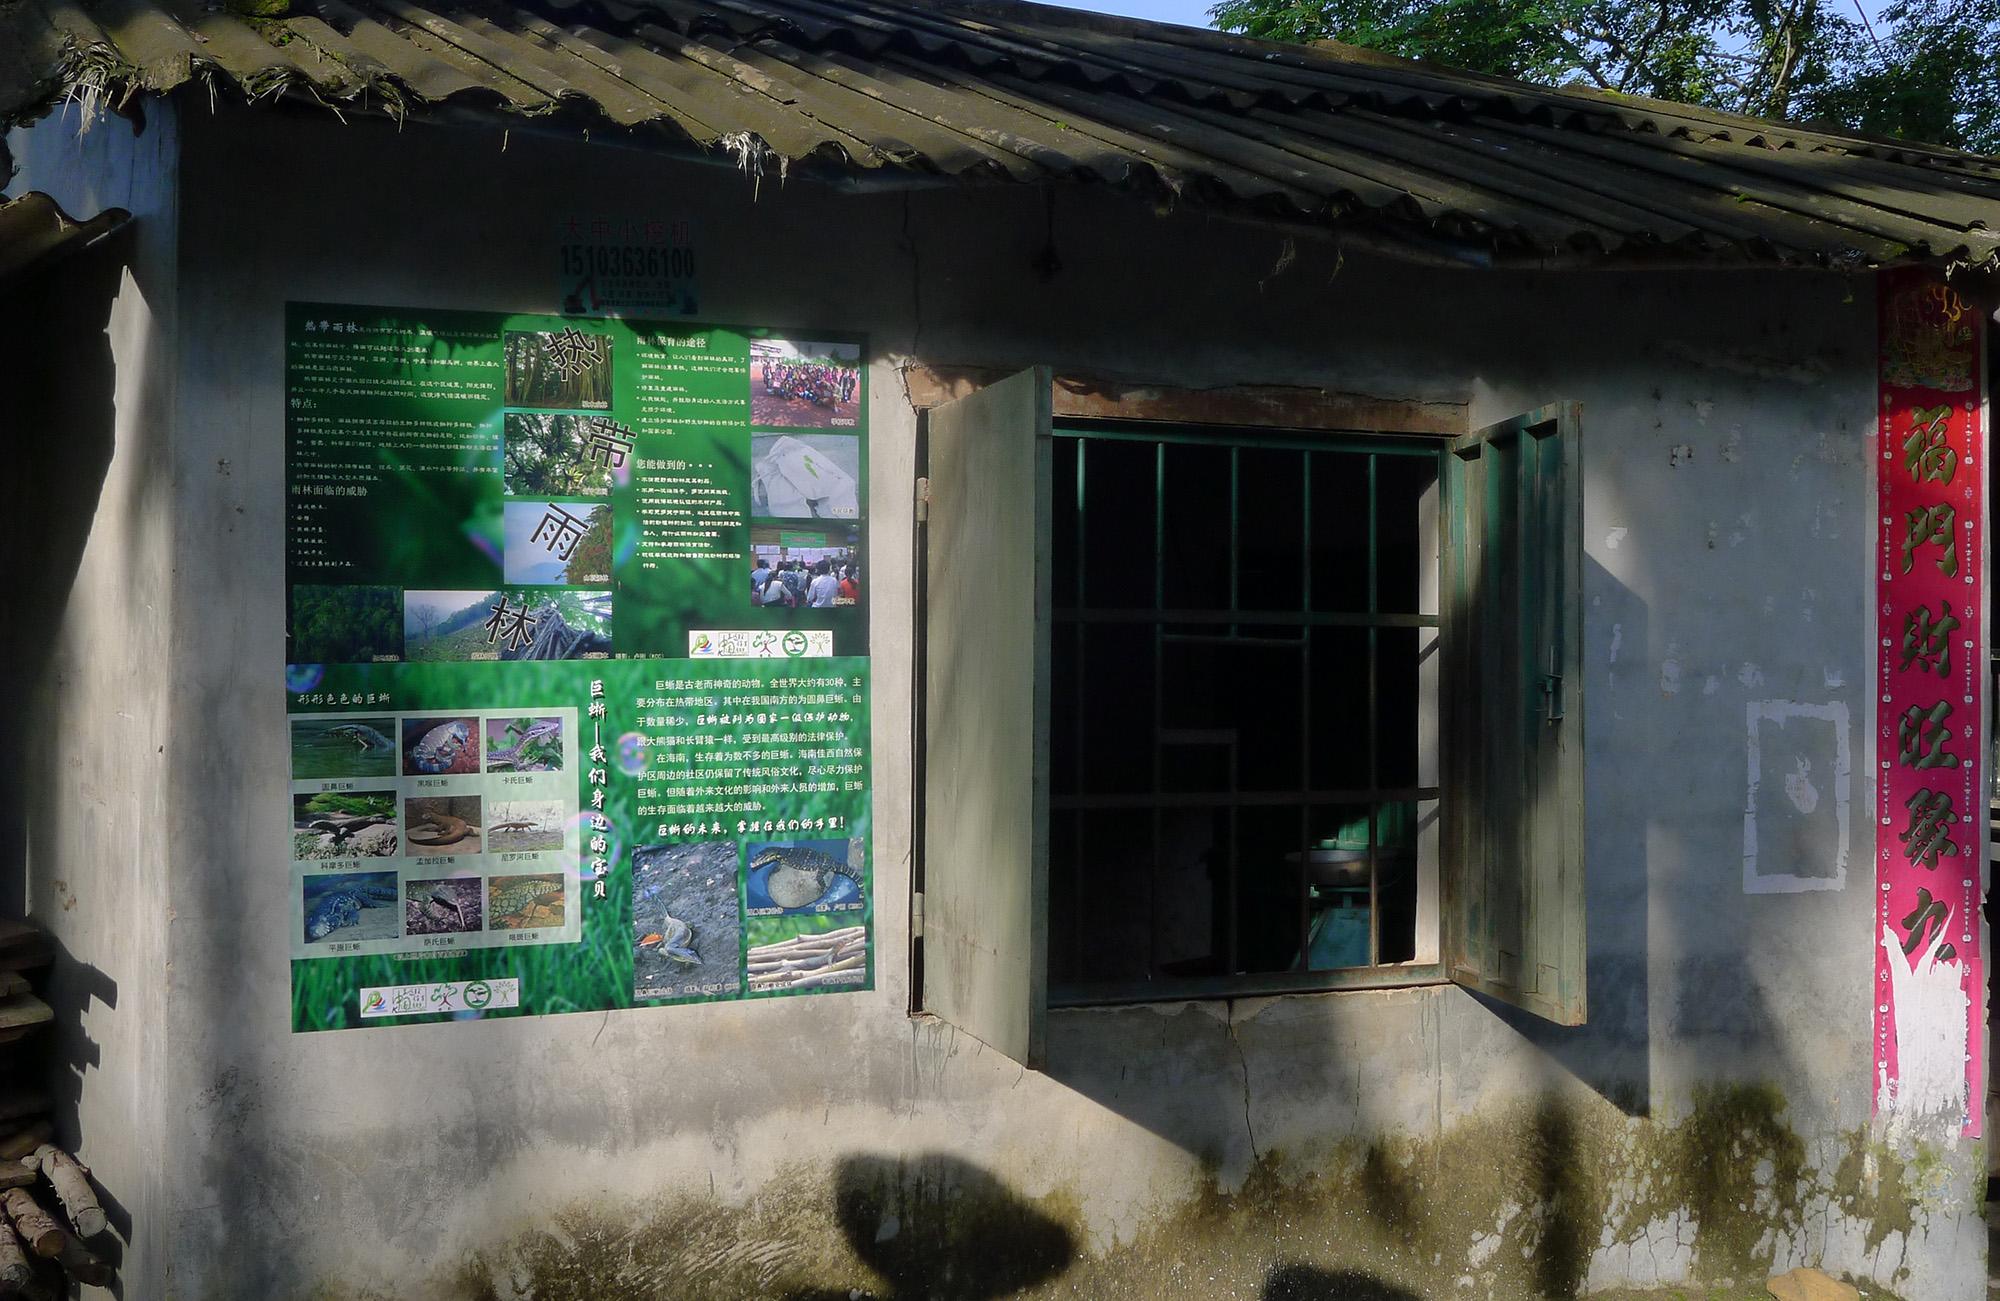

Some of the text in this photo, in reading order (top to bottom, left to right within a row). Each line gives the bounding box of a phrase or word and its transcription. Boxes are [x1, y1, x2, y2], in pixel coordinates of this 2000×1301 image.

[562, 215, 694, 246] 大中小挖机
[561, 245, 695, 279] 15103636100
[291, 484, 369, 497] 雨林面临的威胁
[298, 692, 391, 706] 形形色色的巨蜥
[321, 860, 361, 871] 科摩多巨蜥
[328, 942, 361, 953] 平原巨蜥
